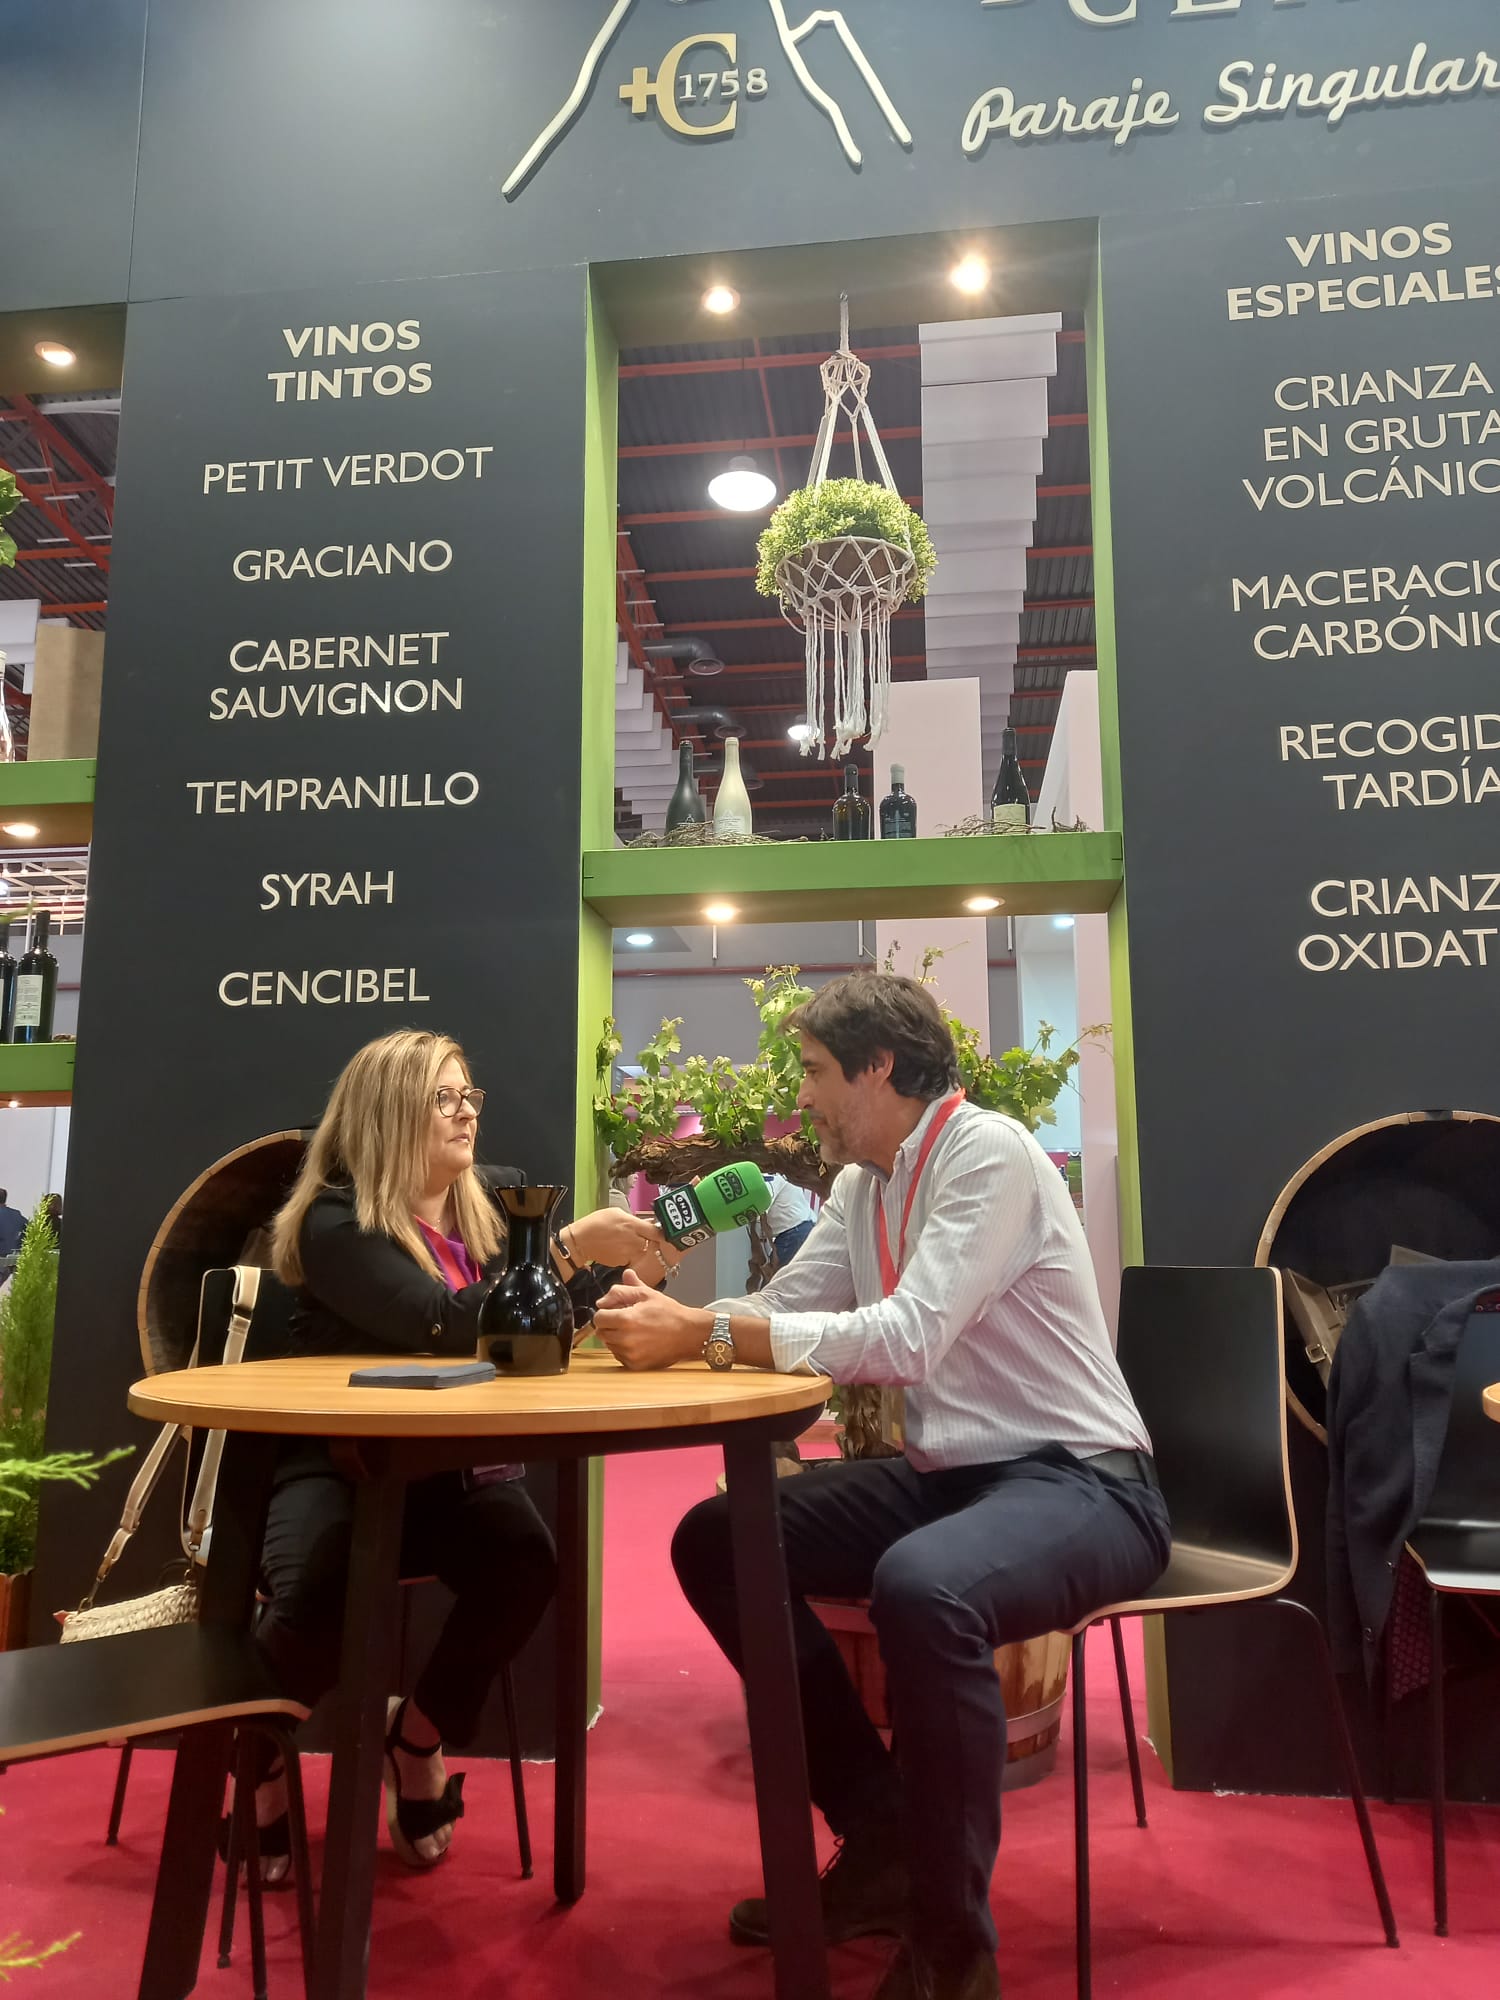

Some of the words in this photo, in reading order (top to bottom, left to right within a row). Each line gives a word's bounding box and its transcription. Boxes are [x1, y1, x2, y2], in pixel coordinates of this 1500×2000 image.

[679, 67, 769, 101] 1758
[961, 77, 1180, 154] Paraje
[1204, 42, 1500, 125] Singular
[1285, 222, 1452, 267] VINOS
[1227, 264, 1500, 321] ESPECIALE
[283, 320, 421, 358] VINOS
[268, 363, 432, 403] TINTOS
[1274, 362, 1494, 412] CRIANZA
[1263, 423, 1329, 462] EN
[203, 457, 313, 494] PETIT
[323, 446, 494, 487] VERDOT
[232, 539, 453, 582] GRACIANO
[229, 631, 450, 673] CABERNET
[209, 677, 463, 721] SAUVIGNON
[186, 771, 480, 815] TEMPRANILLO
[259, 870, 394, 911] SYRAH
[218, 967, 430, 1007] CENCIBEL
[667, 1201, 681, 1226] CERO
[676, 1195, 692, 1223] ONDA
